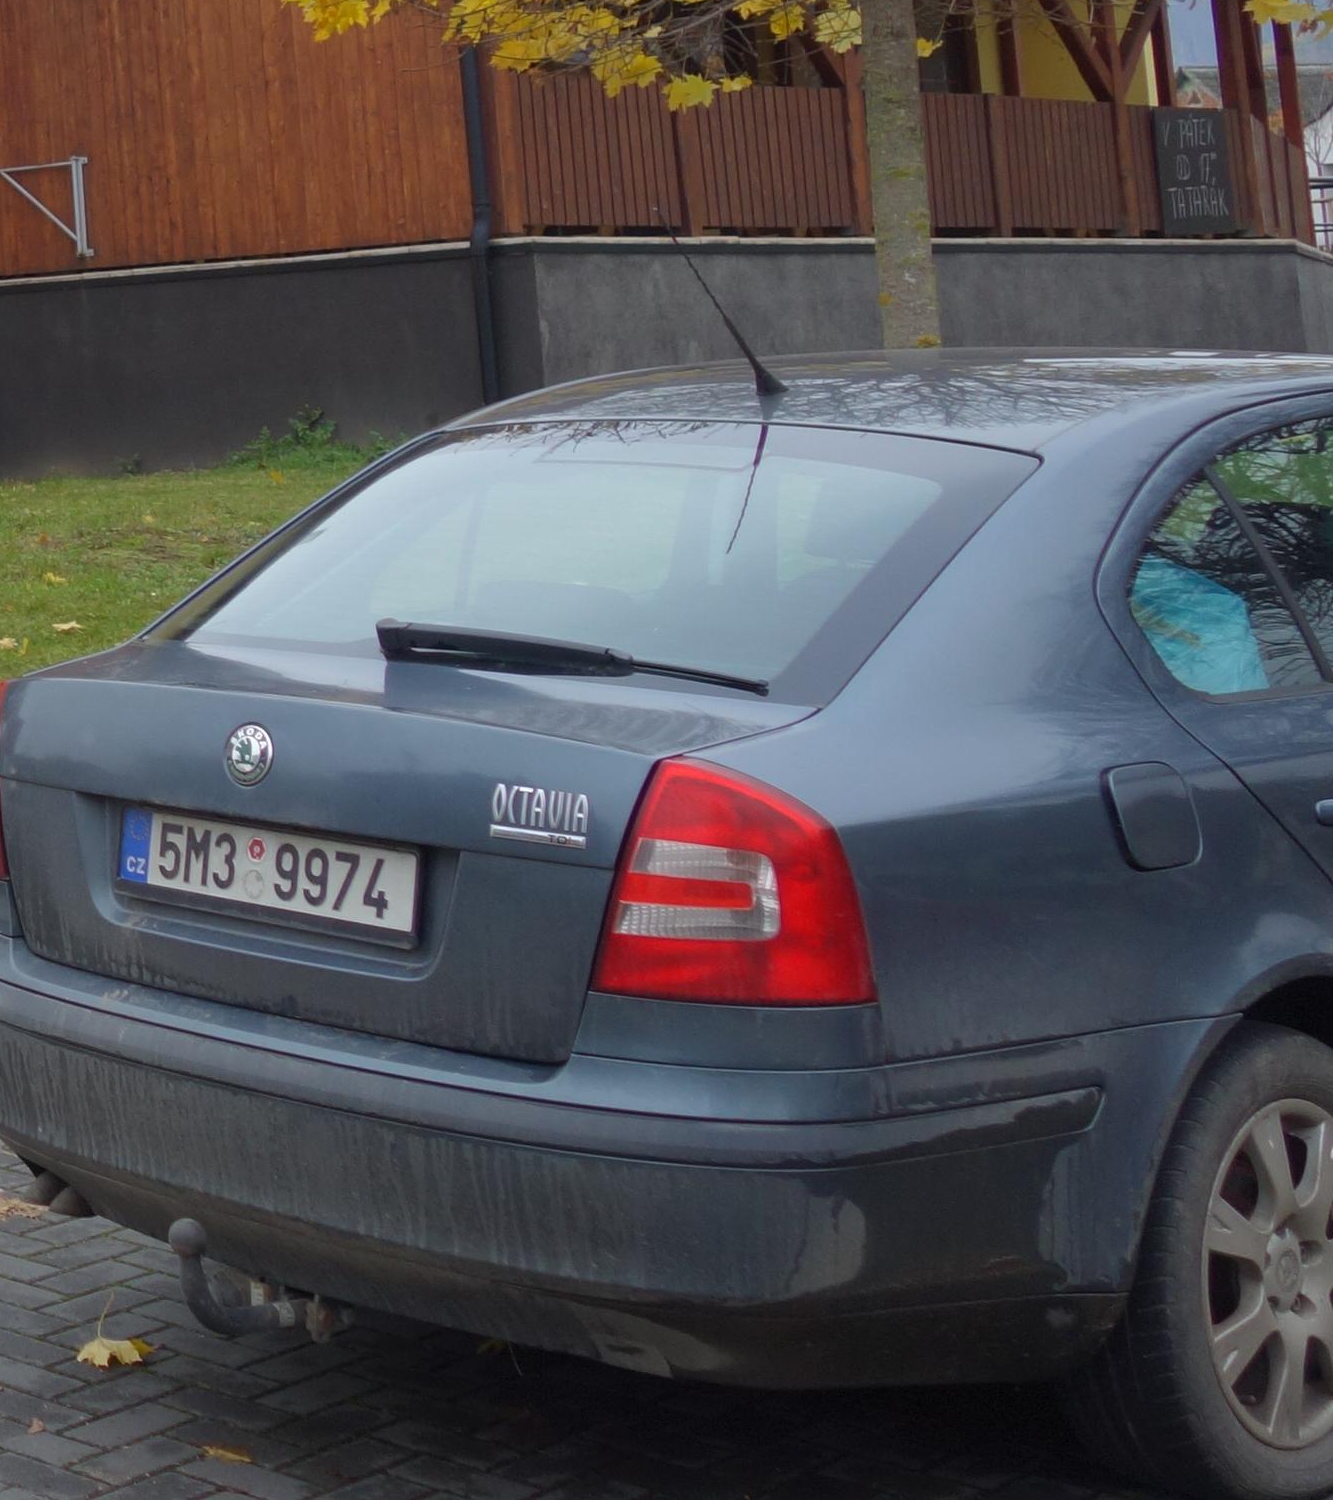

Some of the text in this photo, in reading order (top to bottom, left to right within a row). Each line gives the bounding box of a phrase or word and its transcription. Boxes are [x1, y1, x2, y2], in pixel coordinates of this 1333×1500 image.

[1177, 113, 1216, 149] PÁTEK
[1165, 178, 1230, 220] TATARÁK
[492, 782, 590, 834] OCTAVIA
[126, 855, 146, 875] CZ
[158, 820, 389, 920] 5M3 9974
